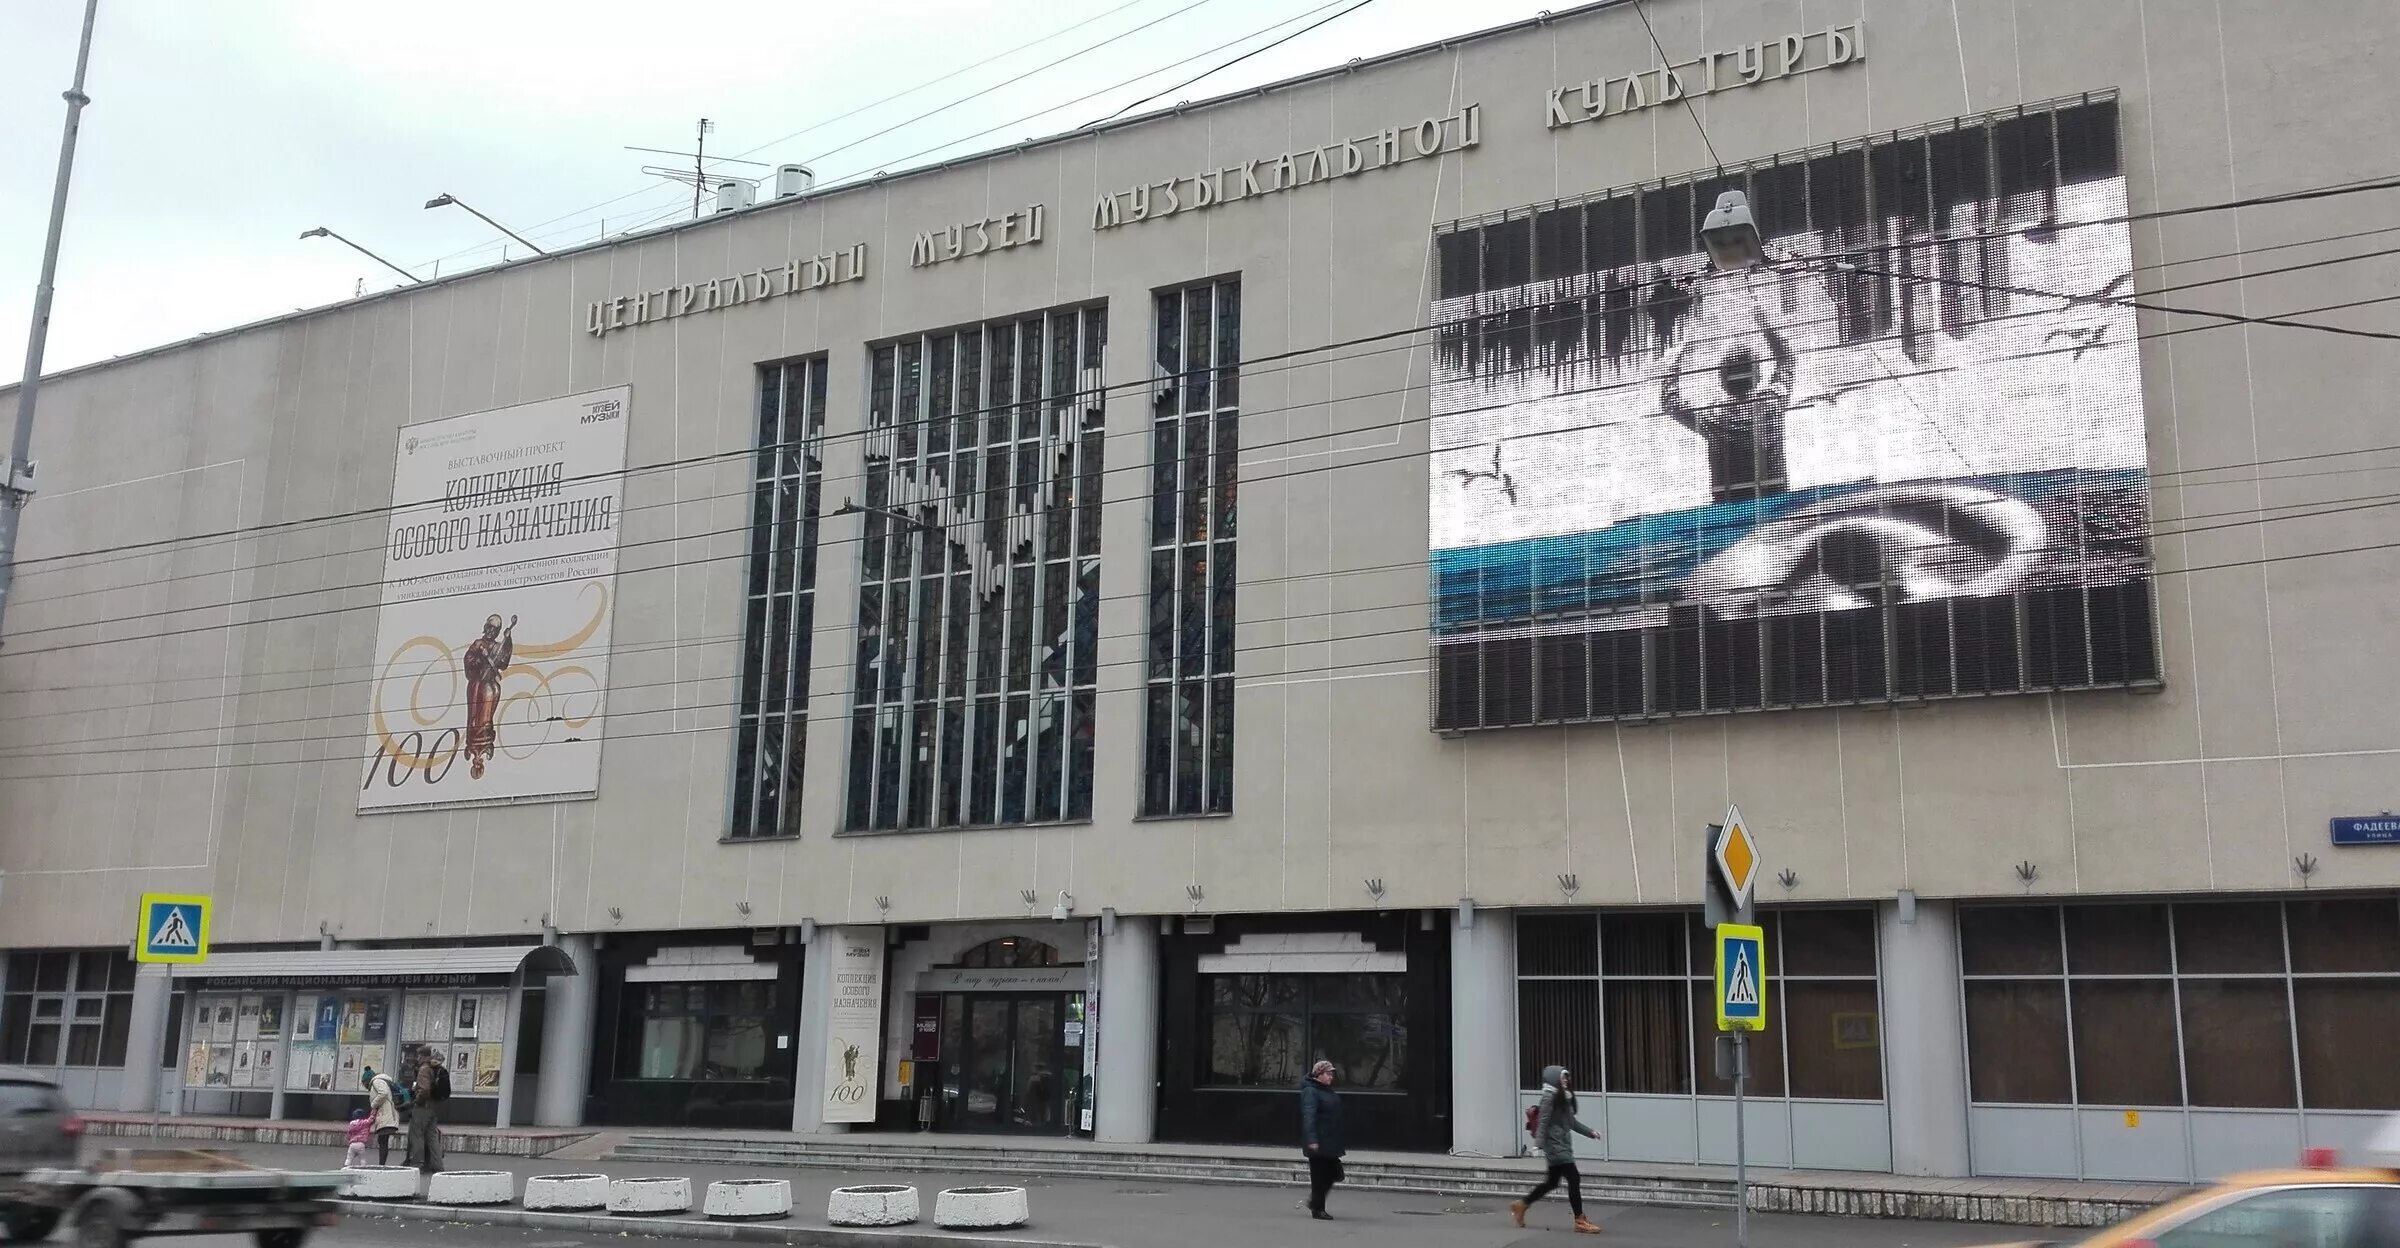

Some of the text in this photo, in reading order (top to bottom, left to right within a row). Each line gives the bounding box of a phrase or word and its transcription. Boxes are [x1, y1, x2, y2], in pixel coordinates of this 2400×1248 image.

[585, 18, 1866, 337] ЦЕНТРАЛЬНЫЙ МУЗЕЙ МУЗЫКАЛЬНОЙ КУЛЬТУРЫ
[447, 440, 566, 470] ВЫСТАВОЧНЫЙ ПРОЕКТ
[442, 462, 563, 513] КОЛЛЕКЦИЯ
[392, 495, 613, 561] ОСОБОГО НАЗНАЧЕНИЯ
[566, 566, 599, 578] России
[362, 727, 460, 790] 100
[424, 974, 476, 984] МУЗЫКИ
[829, 1084, 864, 1102] 100
